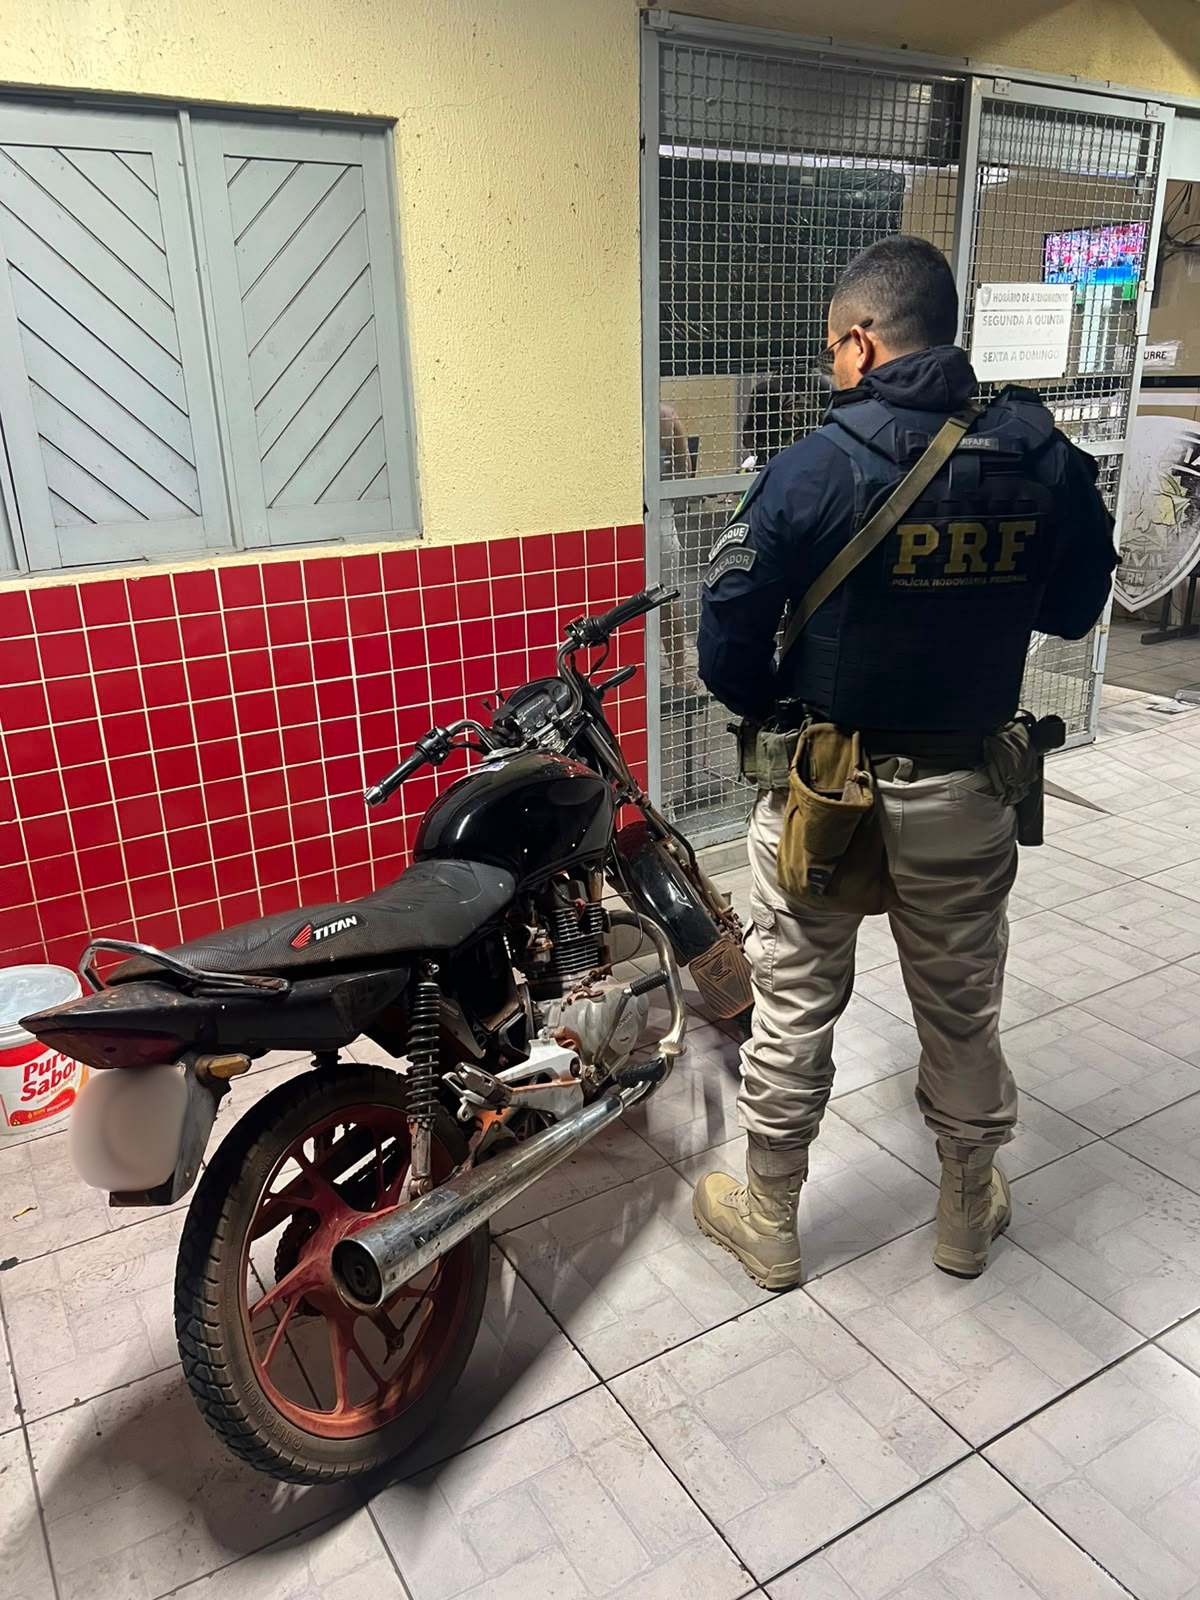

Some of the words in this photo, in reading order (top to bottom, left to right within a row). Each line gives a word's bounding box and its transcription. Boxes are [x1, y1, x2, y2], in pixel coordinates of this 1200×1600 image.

[1022, 293, 1030, 302] DE
[982, 315, 1024, 327] SEGUNDA
[1026, 315, 1033, 326] A
[1034, 314, 1065, 326] QUINTA
[982, 351, 1009, 363] SEXTA
[1010, 351, 1017, 362] A
[1019, 350, 1060, 361] DOMINGO
[1143, 351, 1168, 360] URRE
[961, 438, 991, 447] RFARE
[893, 520, 1036, 574] PRF
[892, 576, 930, 587] POLÍCIA
[313, 915, 358, 941] TITAN
